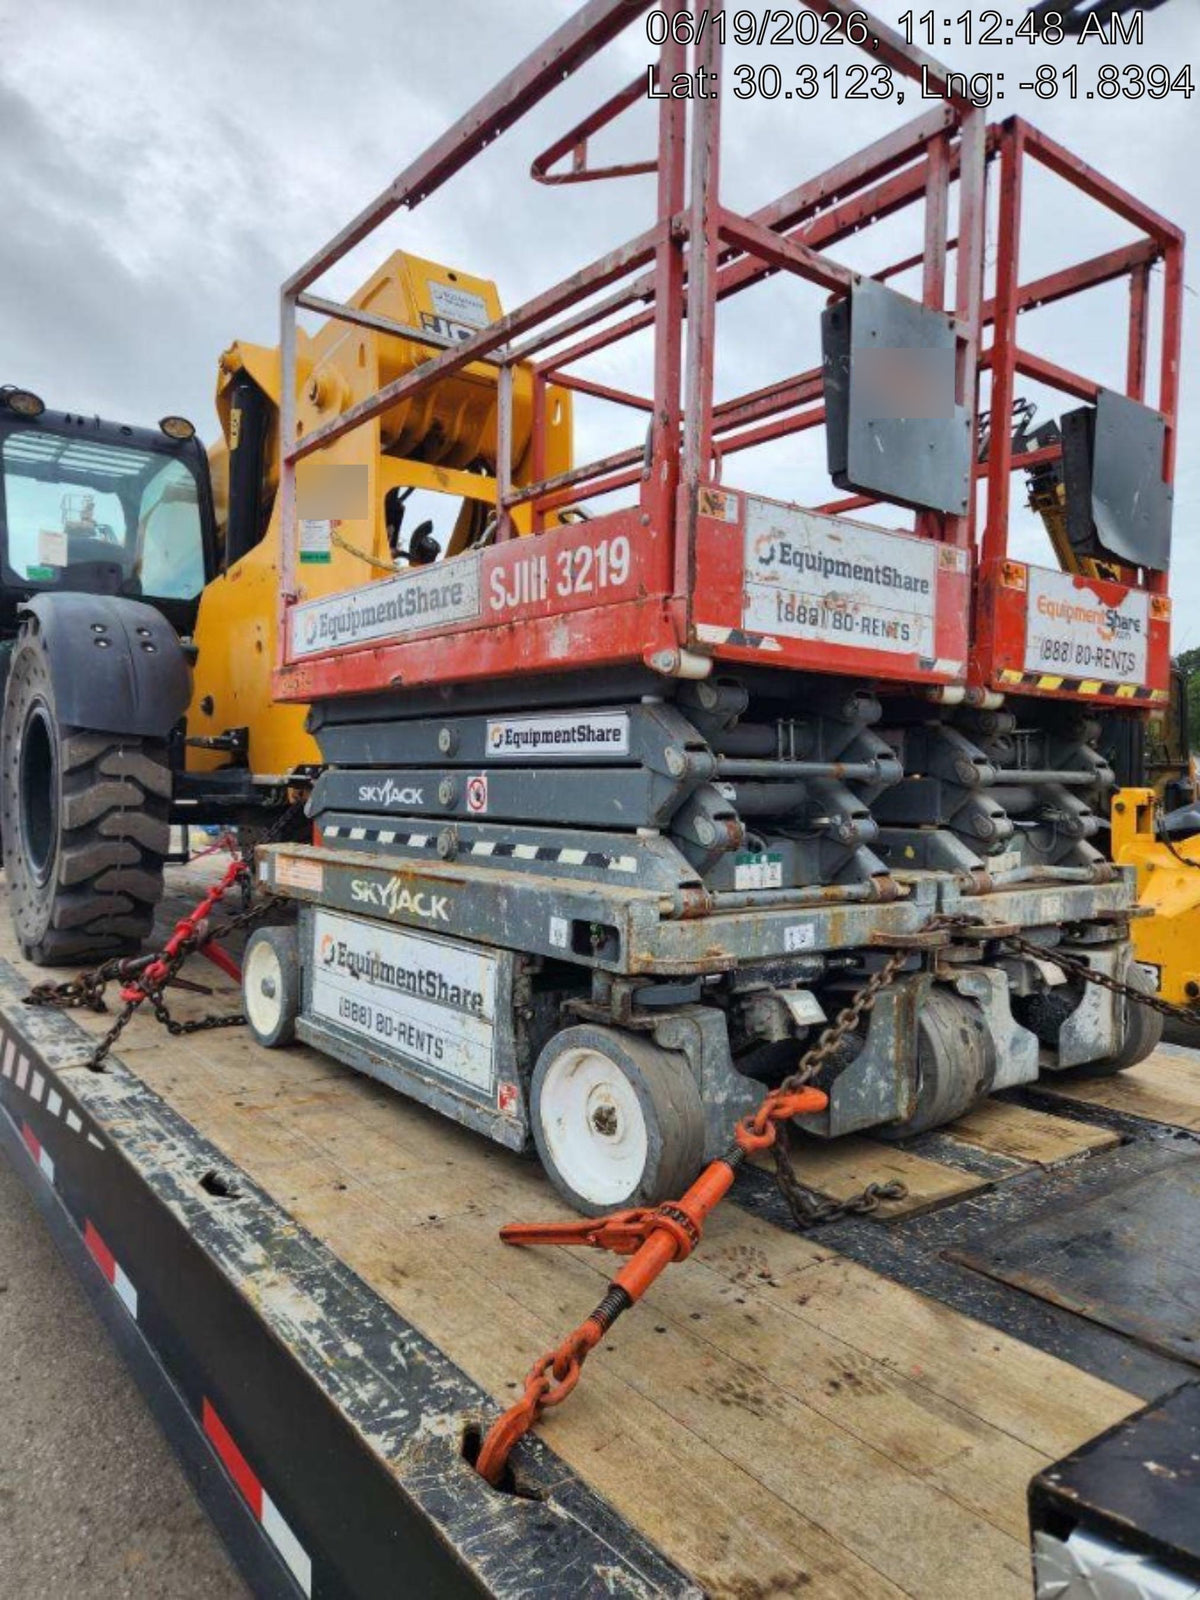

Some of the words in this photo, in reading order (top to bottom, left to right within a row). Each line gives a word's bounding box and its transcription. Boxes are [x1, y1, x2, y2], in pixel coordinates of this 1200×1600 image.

[556, 536, 631, 597] 3219
[778, 541, 930, 595] EquipmentShare
[319, 582, 464, 639] EquipmentShare
[776, 600, 826, 630] (888)
[832, 613, 910, 642] 80-RENTS
[1037, 595, 1142, 634] EquipmentShare
[1040, 639, 1073, 664] (888)
[1075, 644, 1136, 673] 80-RENTS
[504, 723, 622, 748] EquipmentShare
[358, 778, 424, 806] SKYJACK
[351, 876, 451, 922] SKYJACK
[337, 941, 485, 1013] EquipmentShare
[338, 996, 372, 1029] (888)
[376, 1012, 445, 1060] 80-RENTS
